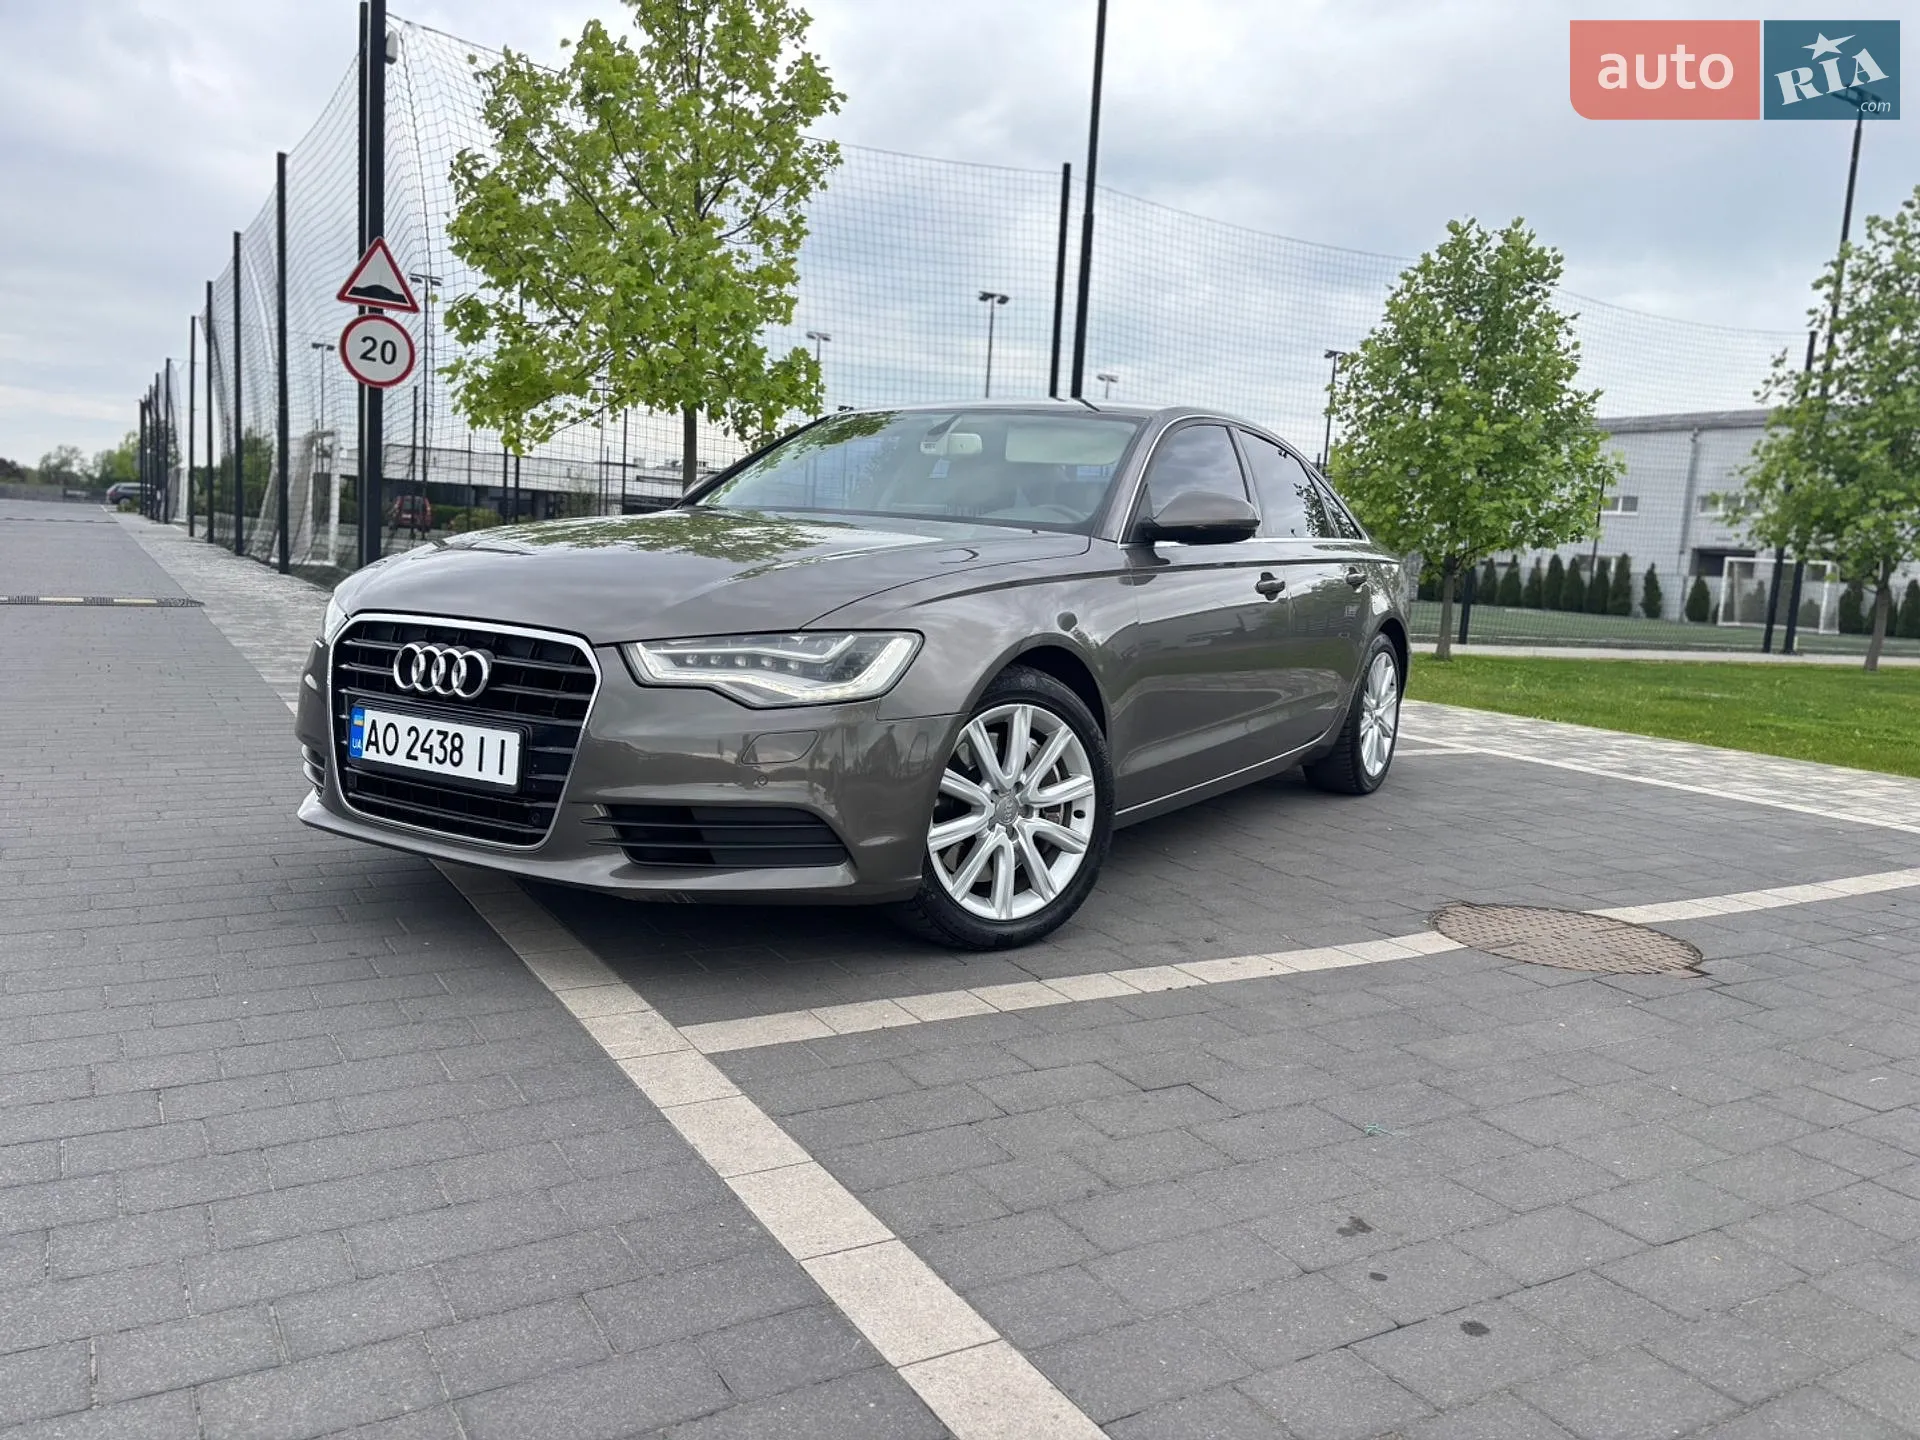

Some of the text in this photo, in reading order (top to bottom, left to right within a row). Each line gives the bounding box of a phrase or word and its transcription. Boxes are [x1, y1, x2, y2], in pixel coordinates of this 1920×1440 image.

[359, 336, 397, 365] 20
[365, 718, 400, 756] AO
[405, 726, 463, 767] 2438
